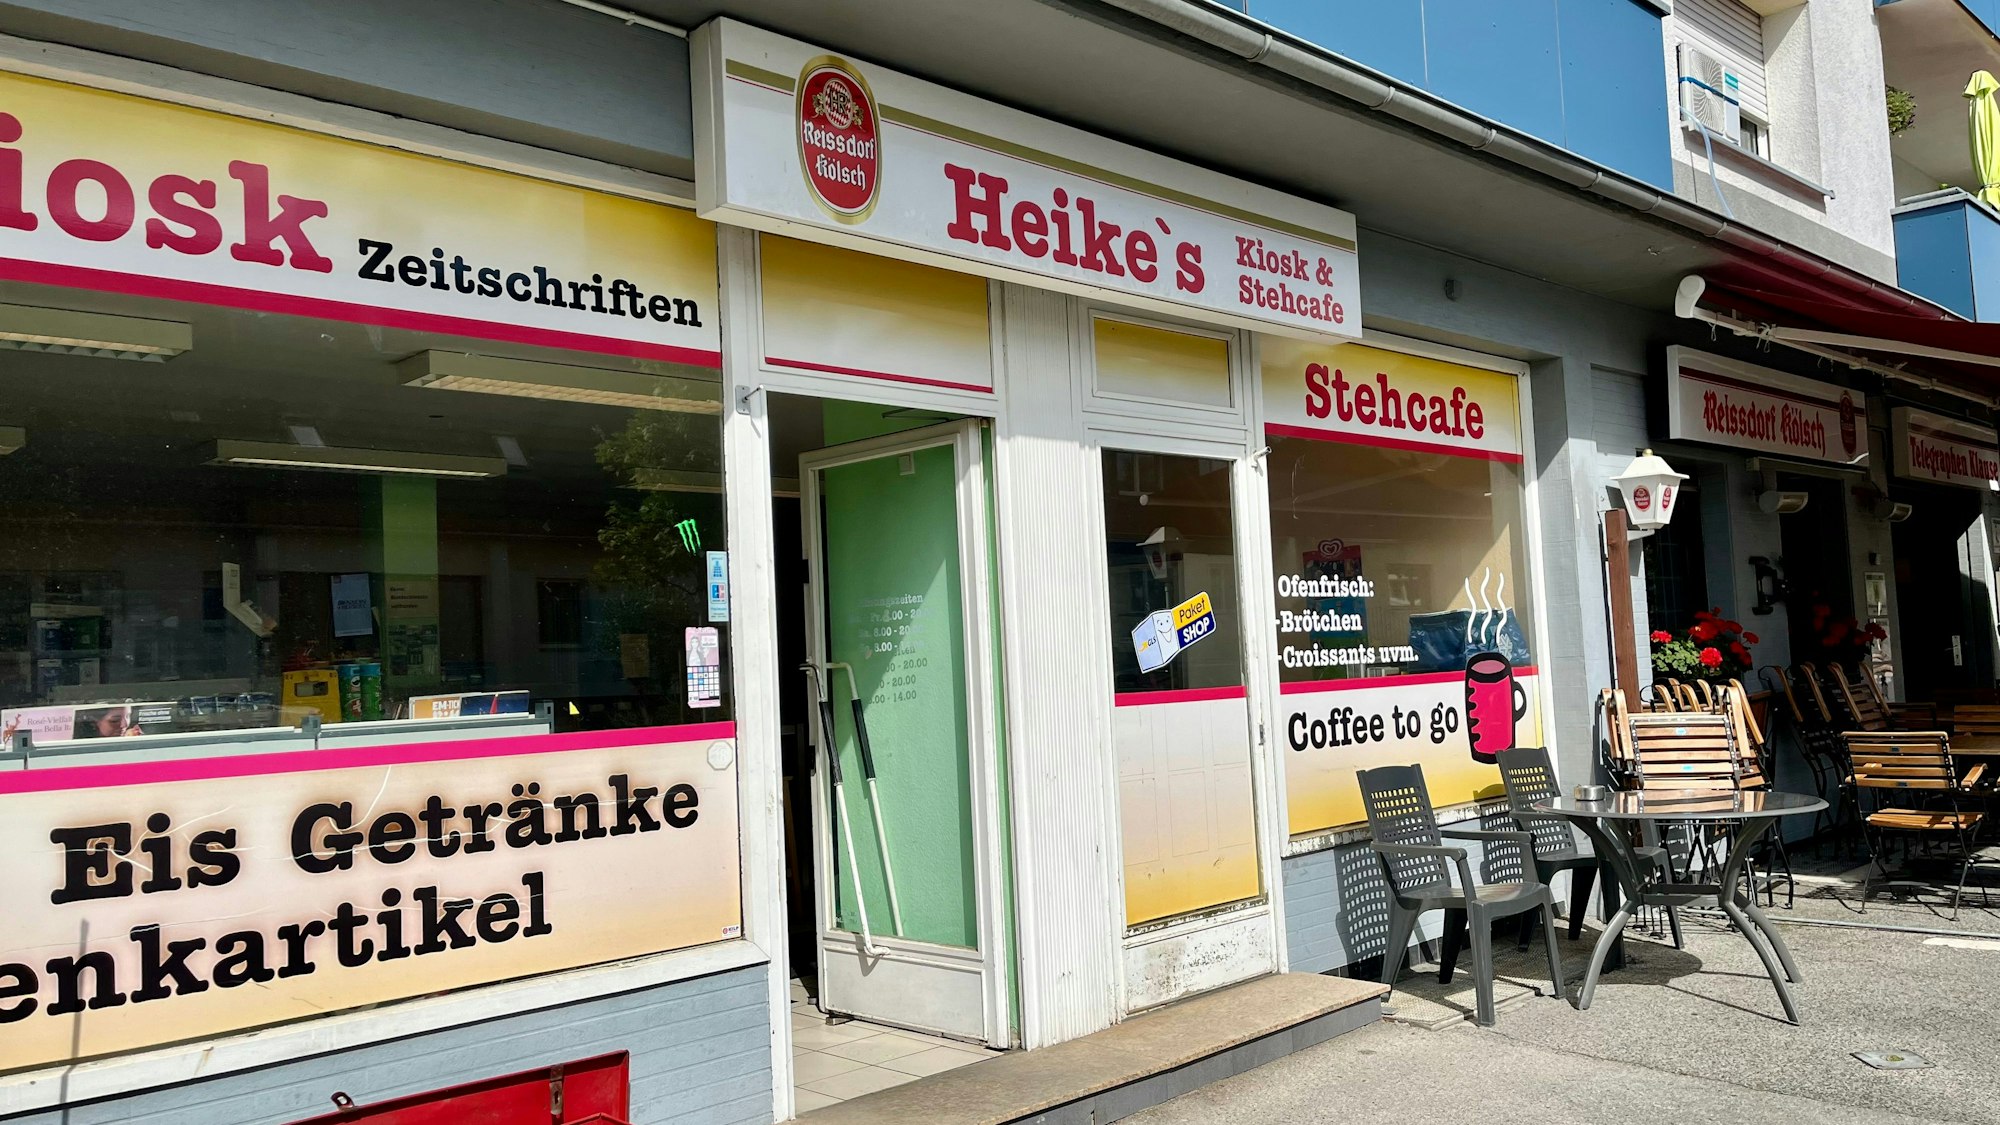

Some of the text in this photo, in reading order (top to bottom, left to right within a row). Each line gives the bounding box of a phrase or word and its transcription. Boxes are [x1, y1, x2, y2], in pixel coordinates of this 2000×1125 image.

[803, 119, 875, 160] Reissdorf
[815, 153, 866, 191] Kölsch
[358, 238, 703, 329] Zeitschriften
[1236, 236, 1334, 287] Kiosk &
[1238, 275, 1344, 324] Stehcafe
[1305, 362, 1485, 440] Stehcafe
[1703, 389, 1826, 457] Reissdorf Kölsch
[1909, 435, 1969, 479] Telegraphen
[1277, 574, 1375, 597] Ofenfrisch:
[1178, 598, 1206, 623] Paket
[1183, 617, 1210, 643] SHOP
[1147, 636, 1157, 647] GLS
[1379, 645, 1419, 662] uvm.
[1288, 702, 1459, 751] Coffee to go
[50, 773, 699, 905] Eis Getränke
